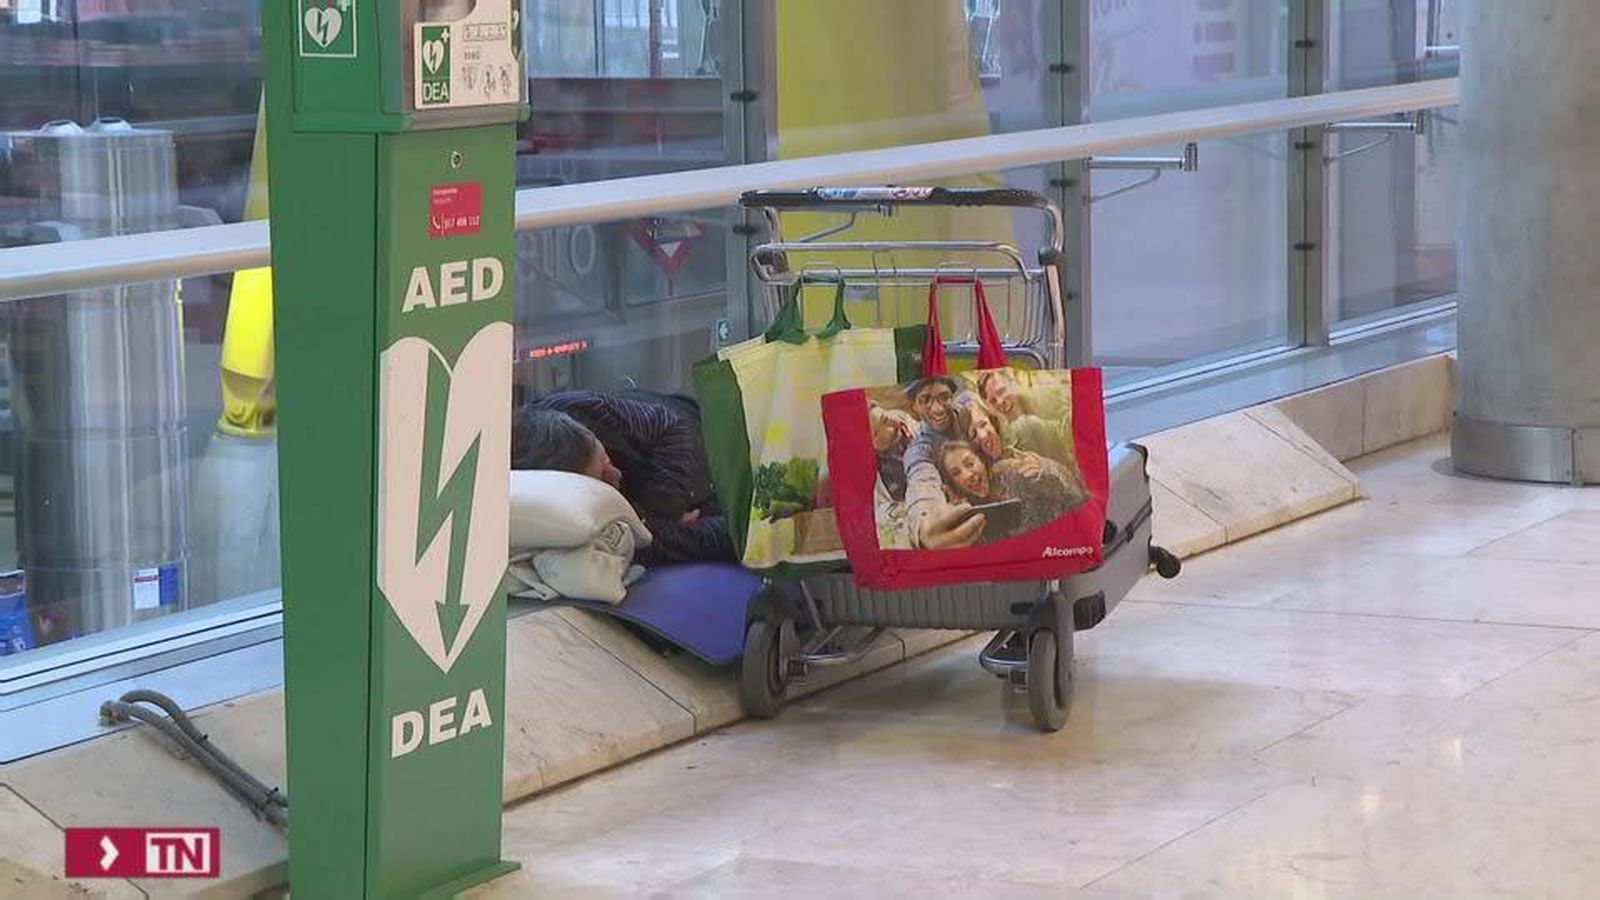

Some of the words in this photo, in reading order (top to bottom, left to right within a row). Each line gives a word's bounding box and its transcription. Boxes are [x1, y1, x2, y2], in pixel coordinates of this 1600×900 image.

[423, 82, 449, 101] DEA
[401, 257, 504, 313] AED
[391, 688, 493, 759] DEA
